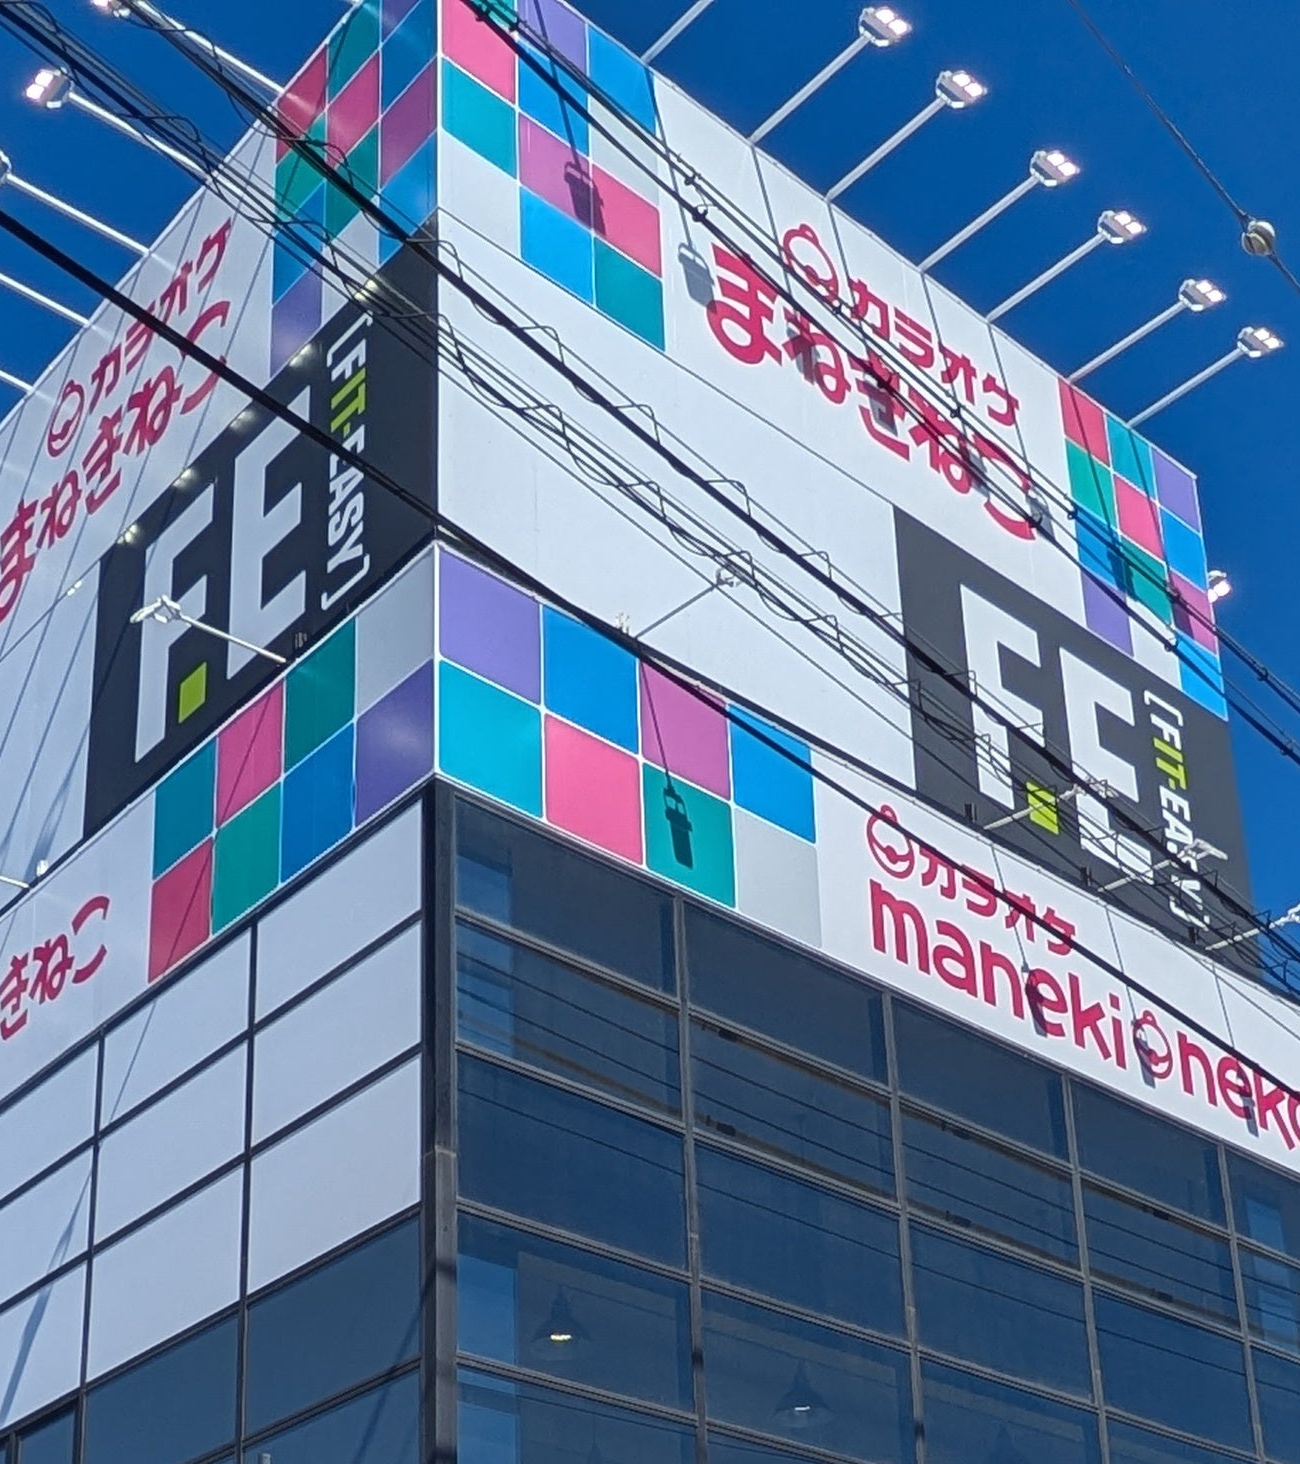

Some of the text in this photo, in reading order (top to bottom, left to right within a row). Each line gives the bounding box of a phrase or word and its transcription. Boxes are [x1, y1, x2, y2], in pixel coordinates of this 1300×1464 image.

[89, 218, 232, 407] カラオケ
[707, 242, 1038, 541] まねきねこ
[849, 278, 1019, 426] カラオケ
[919, 849, 1076, 956] カラオケ
